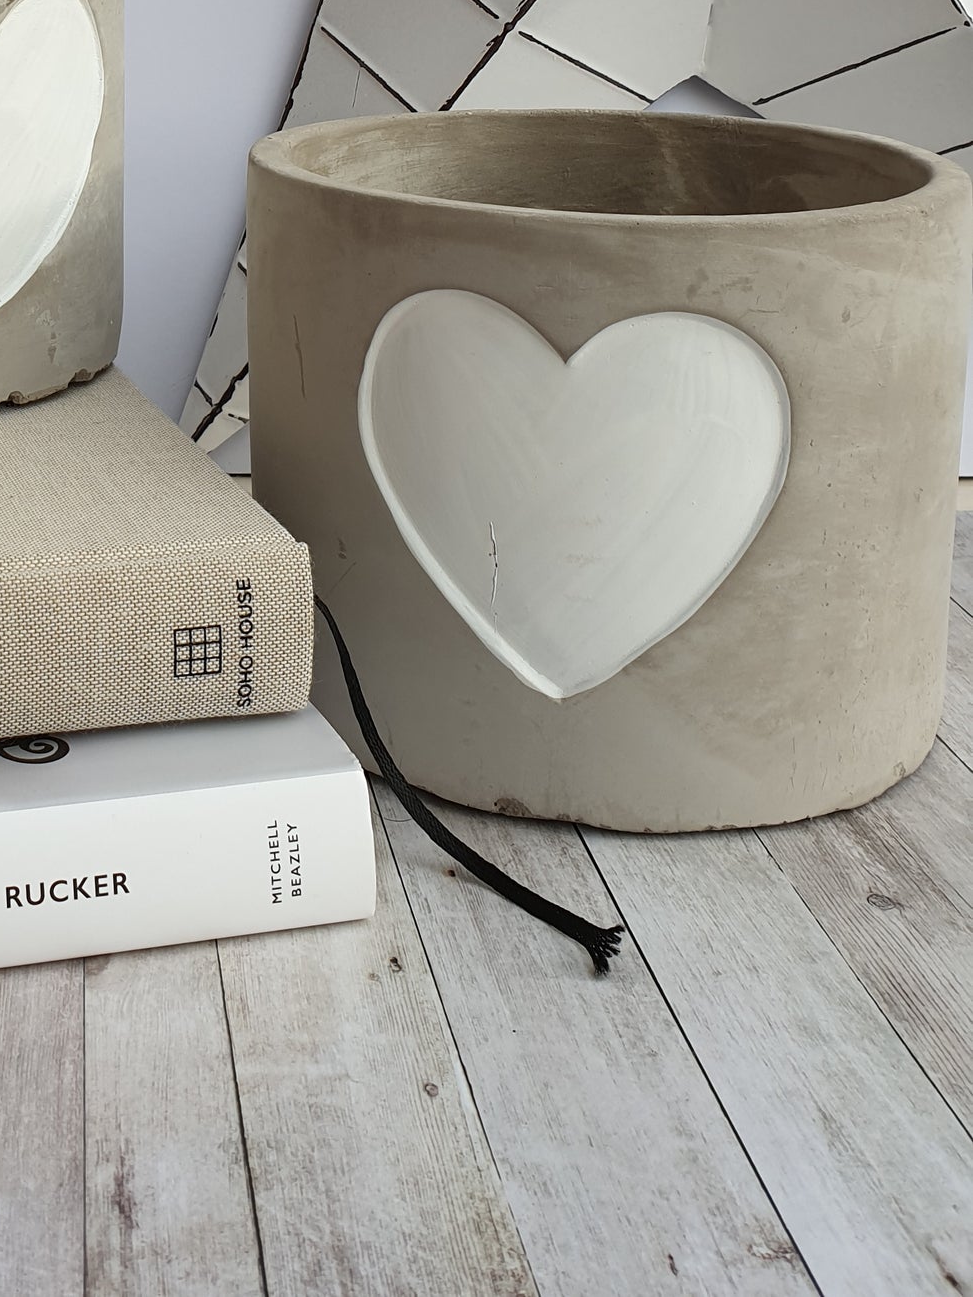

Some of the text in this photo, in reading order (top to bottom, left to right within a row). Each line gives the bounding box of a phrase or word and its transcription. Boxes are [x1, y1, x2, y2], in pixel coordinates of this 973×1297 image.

[236, 577, 253, 708] SOHO HOUSE
[5, 871, 130, 909] RUCKER
[267, 819, 283, 904] MITCHELL
[286, 823, 302, 897] BEAZLEY
